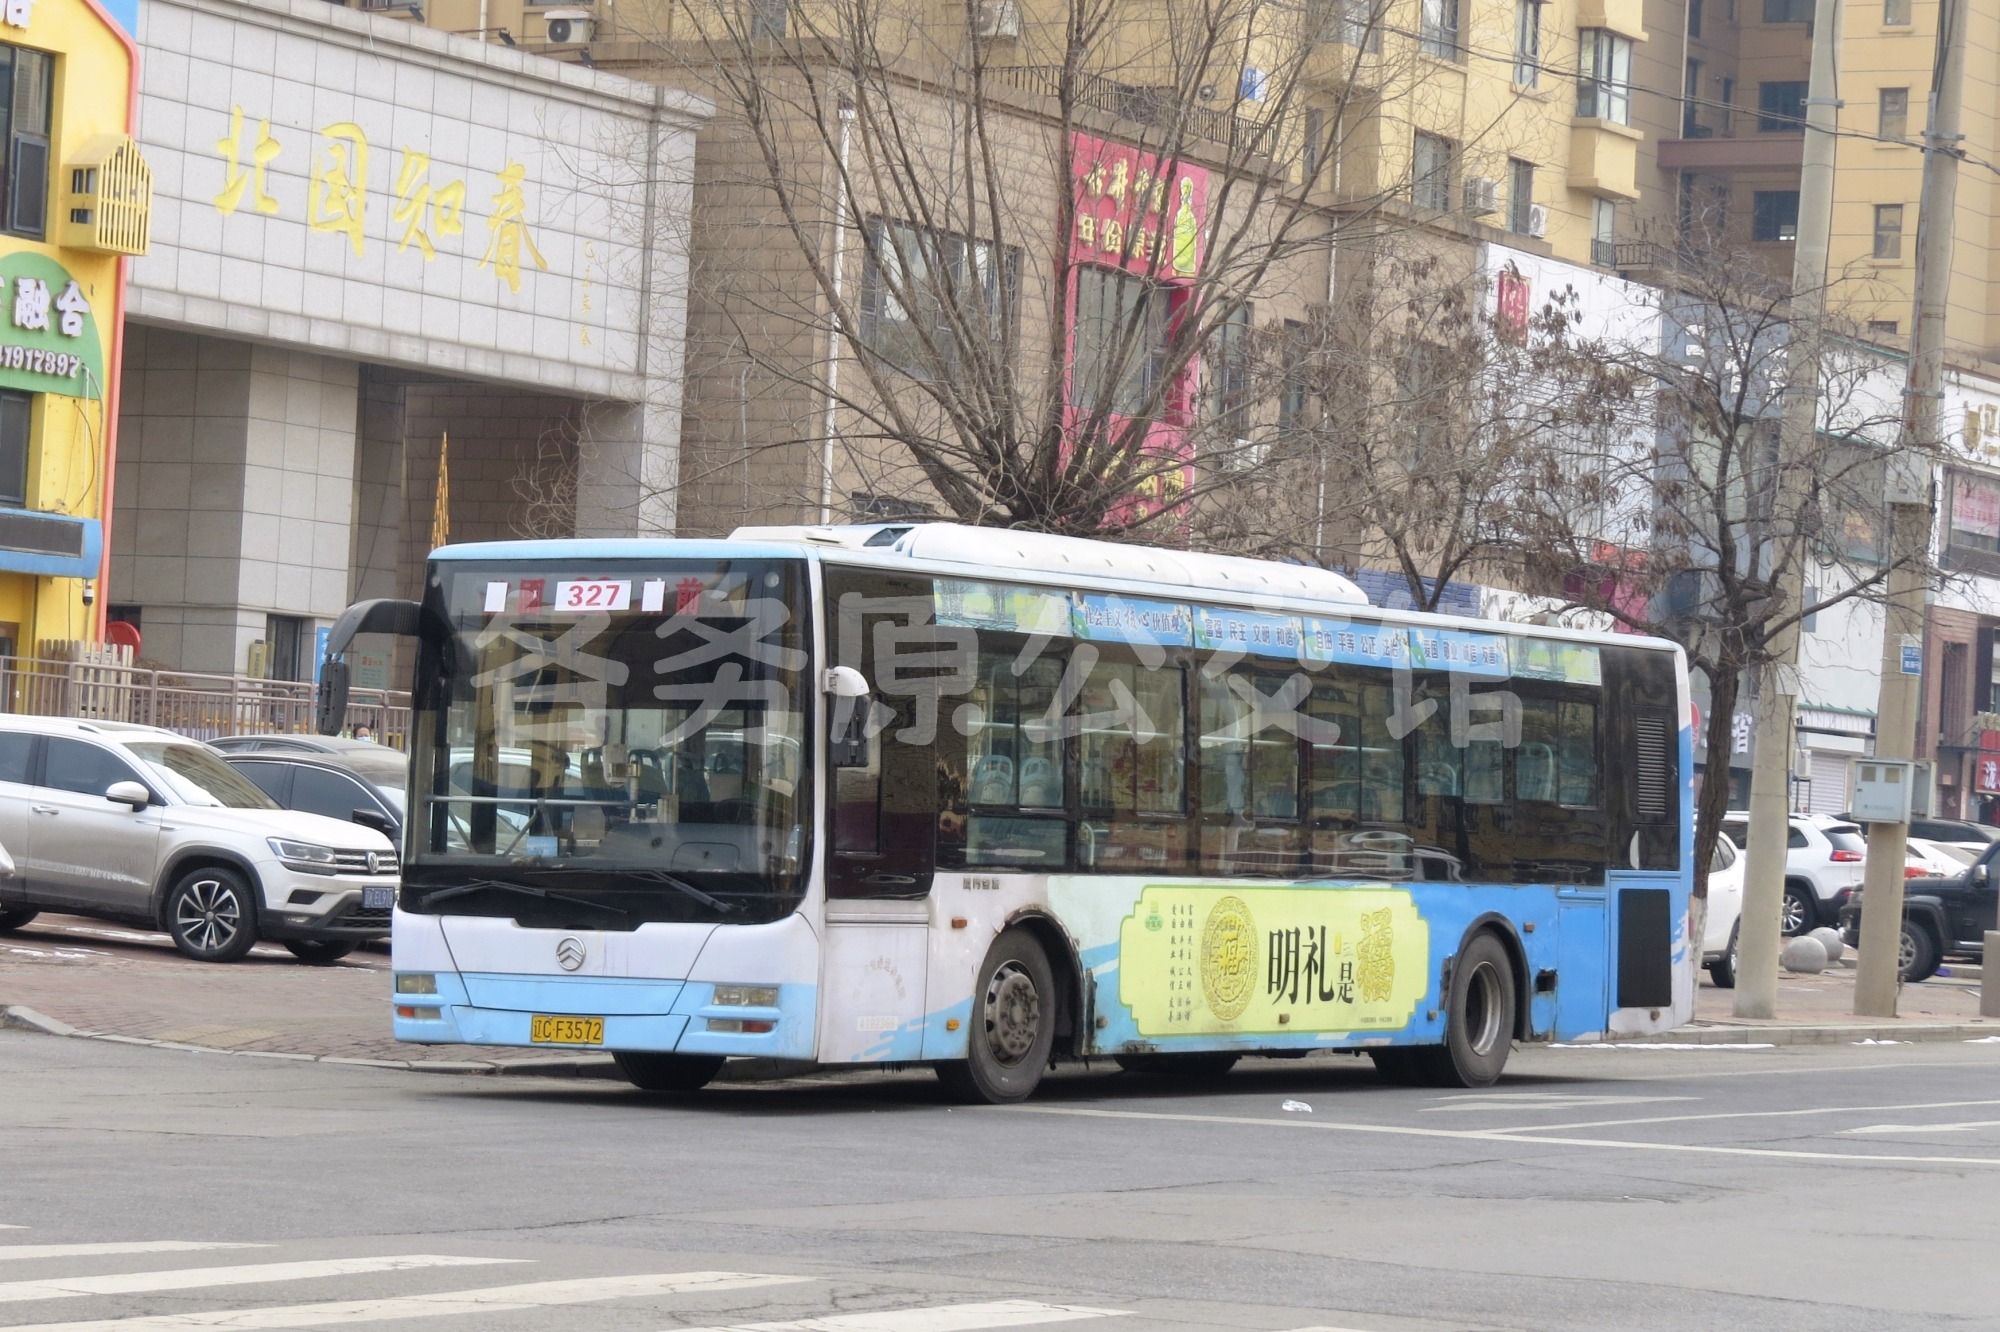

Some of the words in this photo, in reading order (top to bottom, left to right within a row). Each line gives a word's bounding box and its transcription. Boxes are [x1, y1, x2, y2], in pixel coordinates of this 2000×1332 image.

[0, 276, 90, 337] 融合
[0, 345, 80, 378] 1917397
[567, 584, 621, 607] 327
